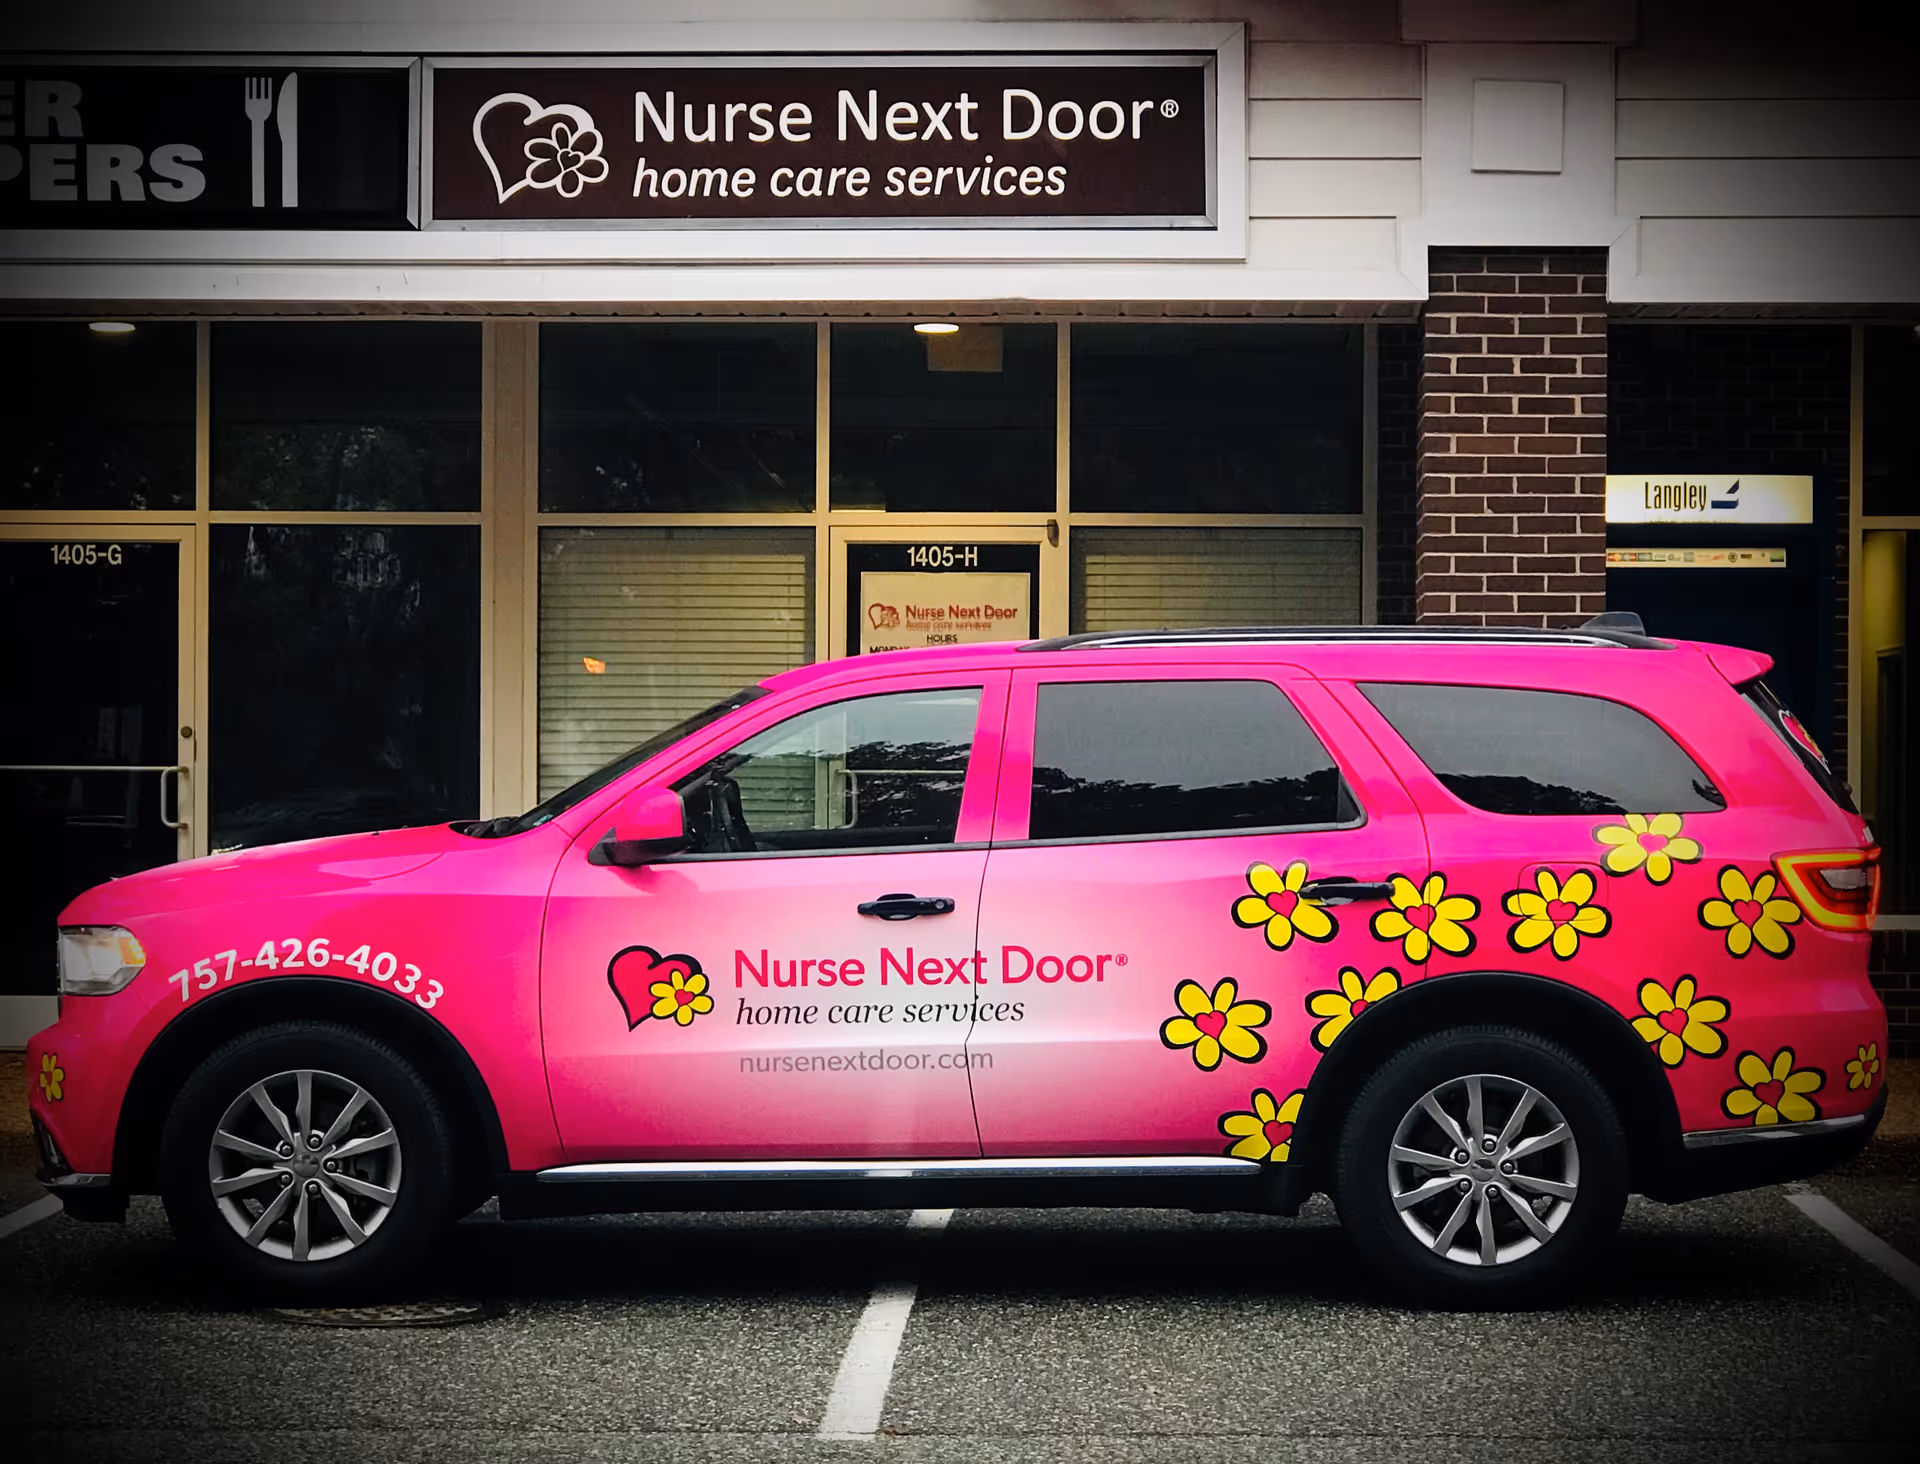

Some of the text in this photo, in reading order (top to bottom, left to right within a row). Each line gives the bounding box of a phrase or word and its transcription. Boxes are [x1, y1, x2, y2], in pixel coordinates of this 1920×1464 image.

[634, 91, 812, 143] Nurse
[838, 89, 979, 142] Next
[632, 154, 1067, 199] home care services
[1644, 481, 1707, 512] Langley
[50, 544, 122, 565] 1405-G
[907, 546, 978, 567] 1405-H
[905, 604, 1018, 621] Nurse Next Door
[926, 634, 958, 643] HOURS
[168, 937, 444, 1010] 757-426-4033
[734, 949, 865, 988] Nurse
[880, 947, 988, 986] Next
[735, 995, 1025, 1025] home care services
[740, 1049, 994, 1073] nursenextdoor.com
